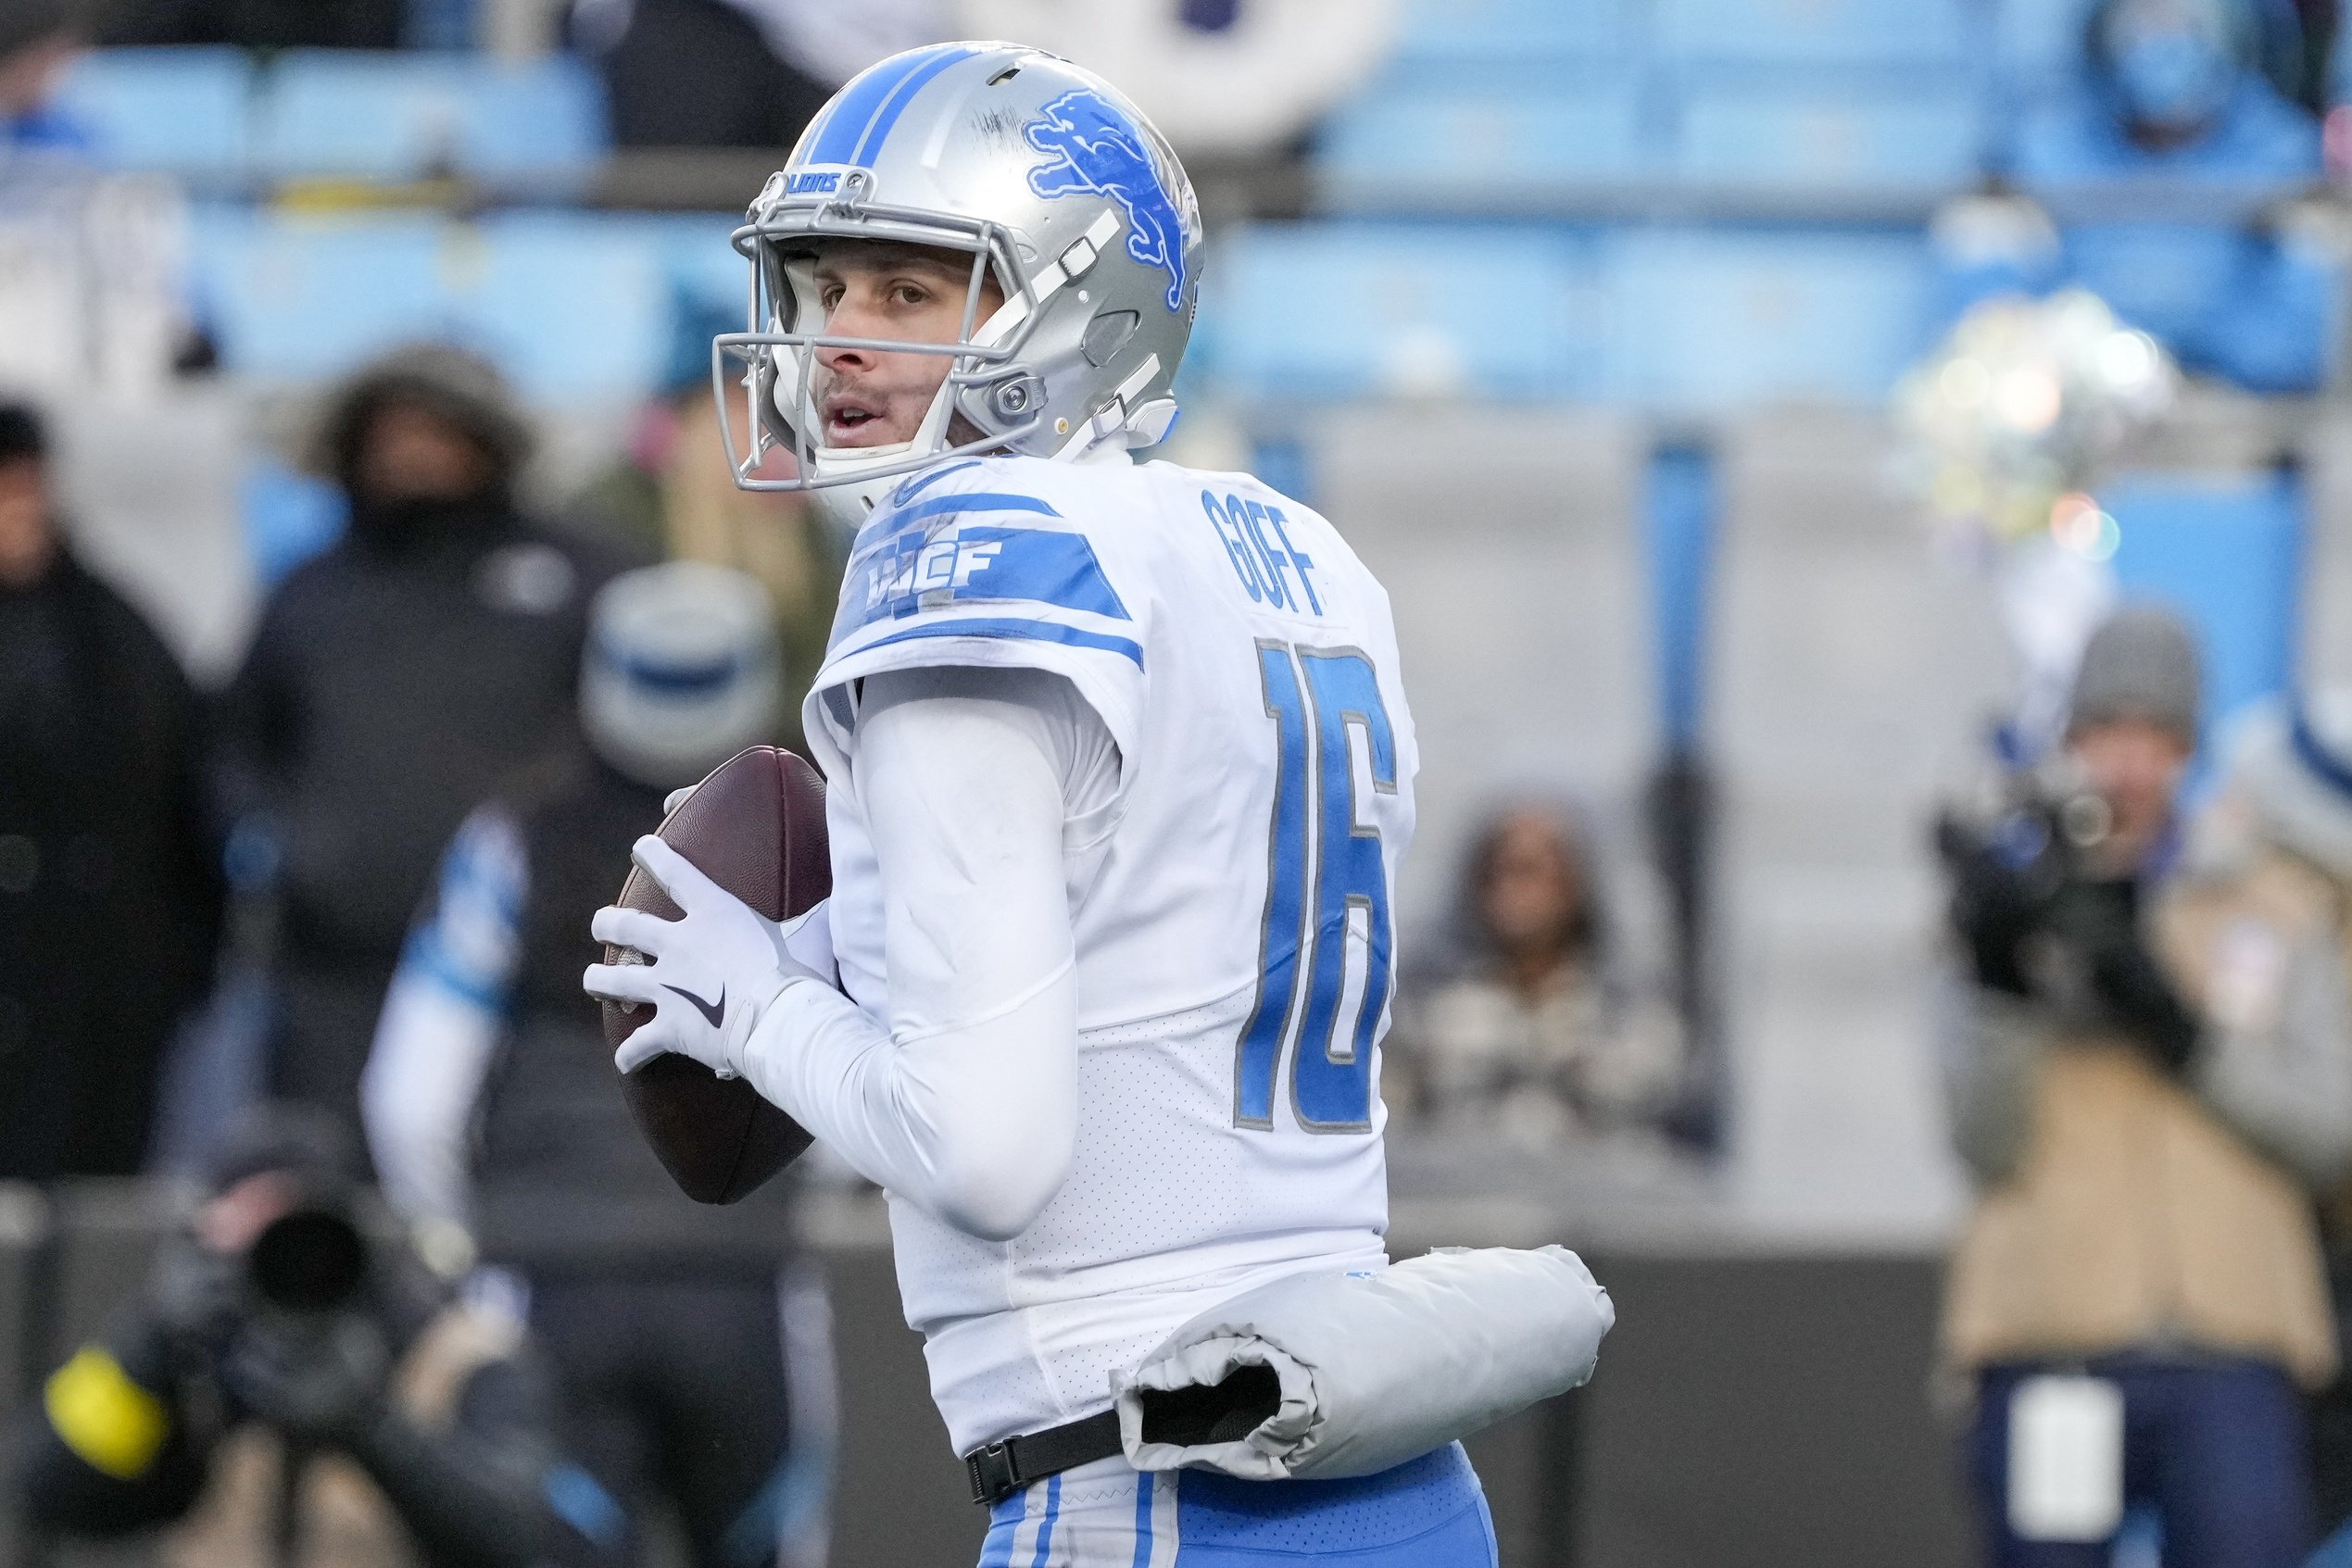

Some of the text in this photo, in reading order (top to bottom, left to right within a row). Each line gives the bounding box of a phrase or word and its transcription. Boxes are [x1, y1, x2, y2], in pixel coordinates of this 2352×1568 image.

[786, 172, 842, 194] LIONS
[865, 541, 1003, 612] WCF
[1201, 489, 1323, 616] GOFF
[1233, 636, 1397, 1135] 16
